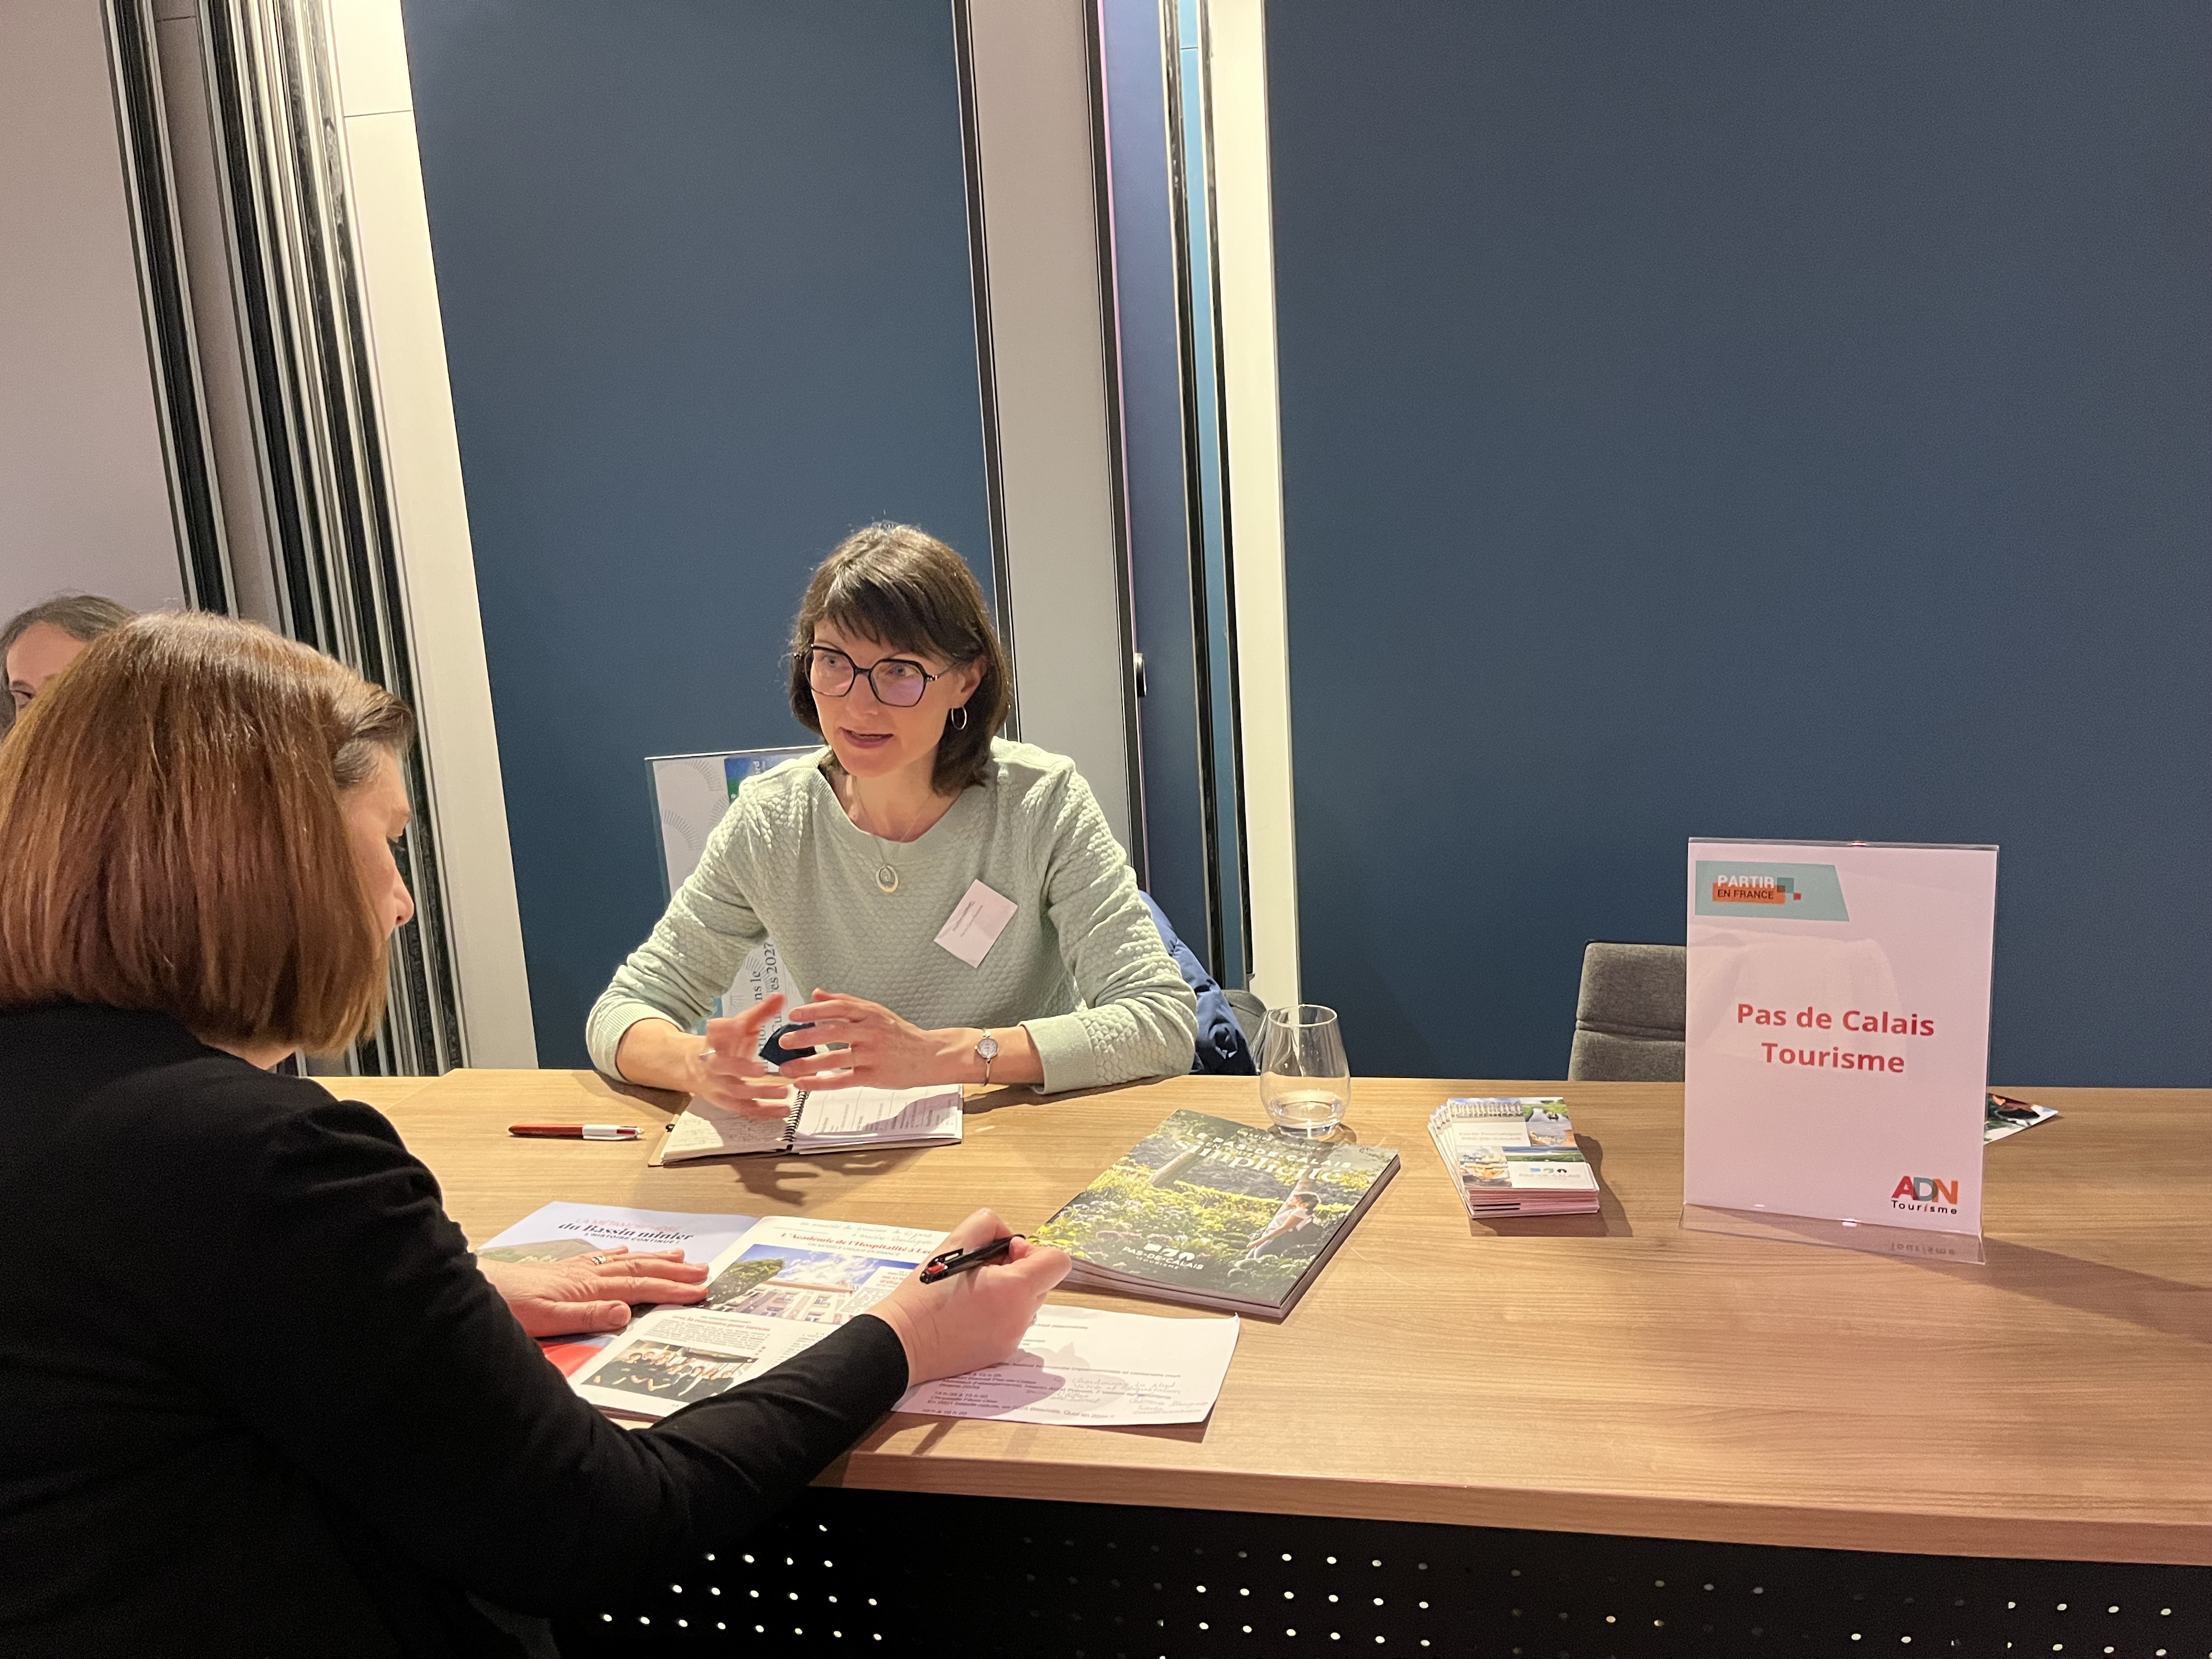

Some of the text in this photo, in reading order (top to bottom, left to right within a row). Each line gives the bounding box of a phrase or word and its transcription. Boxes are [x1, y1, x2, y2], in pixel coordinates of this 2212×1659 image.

[1717, 874, 1775, 889] PARTIR
[1717, 889, 1774, 899] EN FRANCE
[763, 942, 778, 974] 2027
[1737, 1003, 1934, 1037] Pas de Calais
[1761, 1042, 1904, 1073] Tourisme
[1186, 1128, 1207, 1139] LE
[1212, 1137, 1352, 1168] PAS-DE-CALAIS
[1171, 1139, 1342, 1182] simplicité
[1891, 1176, 1959, 1205] ADN
[1891, 1199, 1957, 1215] Tourisme
[583, 1224, 636, 1236] Bassin
[638, 1231, 694, 1241] minier
[584, 1232, 631, 1240] L'HISTOIRE
[781, 1232, 833, 1244] L'Académie
[848, 1239, 906, 1251] l'Hospitalité
[1122, 1246, 1204, 1270] PAS-DE-CALAIS
